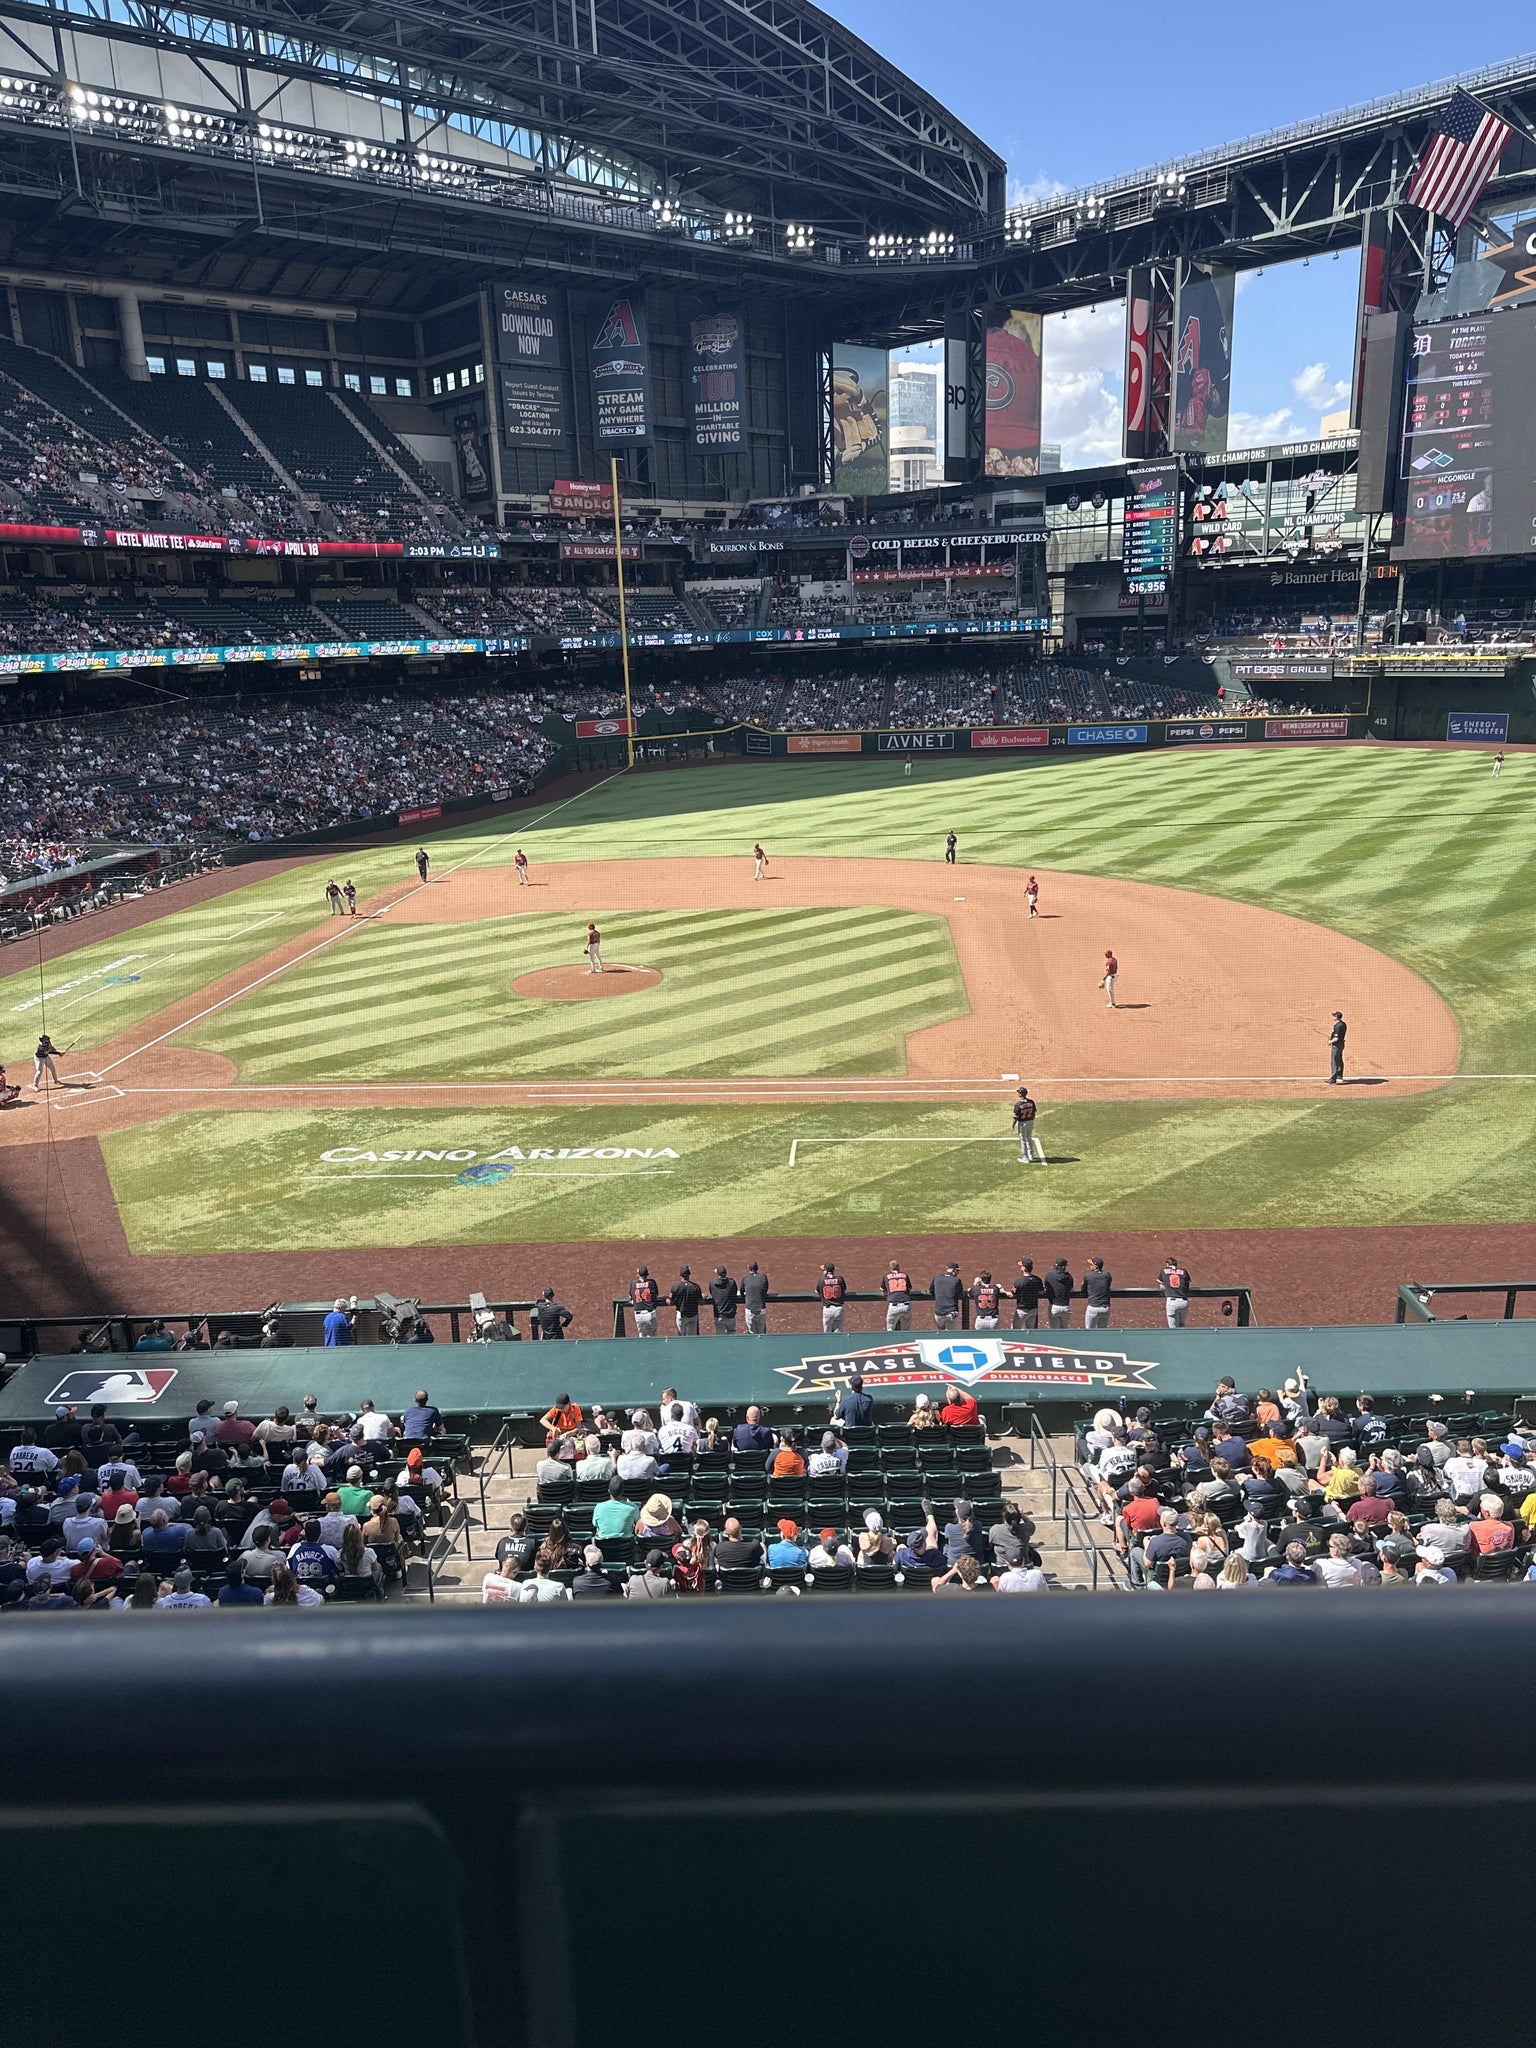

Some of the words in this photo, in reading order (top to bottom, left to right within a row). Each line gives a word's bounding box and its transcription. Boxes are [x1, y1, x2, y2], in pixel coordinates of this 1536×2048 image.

[504, 289, 548, 305] CAESARS
[502, 313, 553, 337] DOWNLOAD
[518, 335, 540, 355] NOW
[1449, 335, 1487, 349] TORRES
[693, 363, 738, 373] CELEBRATING
[597, 392, 644, 405] STREAM
[598, 406, 617, 416] ANY
[619, 404, 645, 414] GAME
[694, 401, 740, 414] MILLION
[520, 411, 550, 419] LOCATION
[599, 414, 645, 425] ANYWHERE
[713, 414, 722, 422] IN
[510, 426, 562, 436] 623.304.0777
[696, 422, 740, 432] CHARITABLE
[696, 431, 740, 444] GIVING
[1282, 444, 1308, 456] WORLD
[1310, 438, 1357, 452] CHAMPIONS
[1189, 458, 1198, 466] NL
[1200, 454, 1221, 466] WEST
[1222, 450, 1266, 463] CHAMPIONS
[1437, 472, 1476, 484] MCGONIGLE
[569, 482, 600, 492] Honeywell
[553, 496, 615, 510] SANDLO
[1416, 497, 1424, 509] 0
[1436, 494, 1443, 506] 0
[1284, 516, 1296, 526] NL
[1296, 512, 1346, 526] CHAMPIONS
[1202, 523, 1220, 534] WILD
[1222, 521, 1242, 532] CARD
[116, 532, 142, 547] KETEL
[142, 534, 168, 548] MARTE
[169, 535, 184, 550] TEE
[710, 543, 748, 553] BOURBON
[750, 542, 758, 551] &
[758, 541, 784, 550] BONES
[872, 540, 900, 550] COLD
[903, 538, 940, 549] BEERS
[942, 538, 949, 547] &
[951, 532, 1048, 547] CHEESEBURGERS
[284, 542, 307, 556] APRIL
[308, 543, 318, 556] 18
[409, 546, 428, 556] 2:03
[430, 546, 445, 556] PM
[614, 547, 630, 555] SATS
[884, 572, 898, 581] Your
[898, 570, 934, 580] Neighborhood
[956, 568, 970, 576] Joint
[1285, 572, 1328, 585] Banner
[1128, 582, 1166, 594] $16,956
[66, 658, 86, 668] Baja
[86, 656, 110, 666] Blast
[128, 656, 146, 664] Baja
[146, 654, 168, 664] Blast
[200, 652, 219, 660] Blast
[1235, 666, 1252, 674] PIT
[1254, 666, 1285, 674] BOSS
[1290, 666, 1328, 674] GRILLS
[1282, 722, 1321, 730] MEMBERSHIPS
[1374, 718, 1388, 726] 413
[1464, 720, 1497, 728] ENERGY
[1078, 730, 1122, 742] CHASE
[1170, 728, 1194, 736] PEPSI
[1218, 726, 1243, 735] PEPSI
[886, 734, 946, 748] AVNET
[1001, 734, 1042, 744] Budweiser
[1052, 737, 1066, 746] 374
[319, 1147, 477, 1163] CASINO
[496, 1145, 681, 1162] ARIZONA
[634, 1288, 651, 1303] 14
[817, 1356, 916, 1375] CHASE
[1014, 1356, 1114, 1371] FIELD
[861, 1376, 889, 1384] OME
[922, 1373, 945, 1381] THE
[990, 1373, 1083, 1382] DIAMONDBACKS
[672, 1436, 683, 1452] 4
[12, 1452, 39, 1462] CABRERA
[14, 1462, 36, 1472] 24
[504, 1542, 527, 1553] MARTE
[295, 1550, 324, 1562] RAMIREZ
